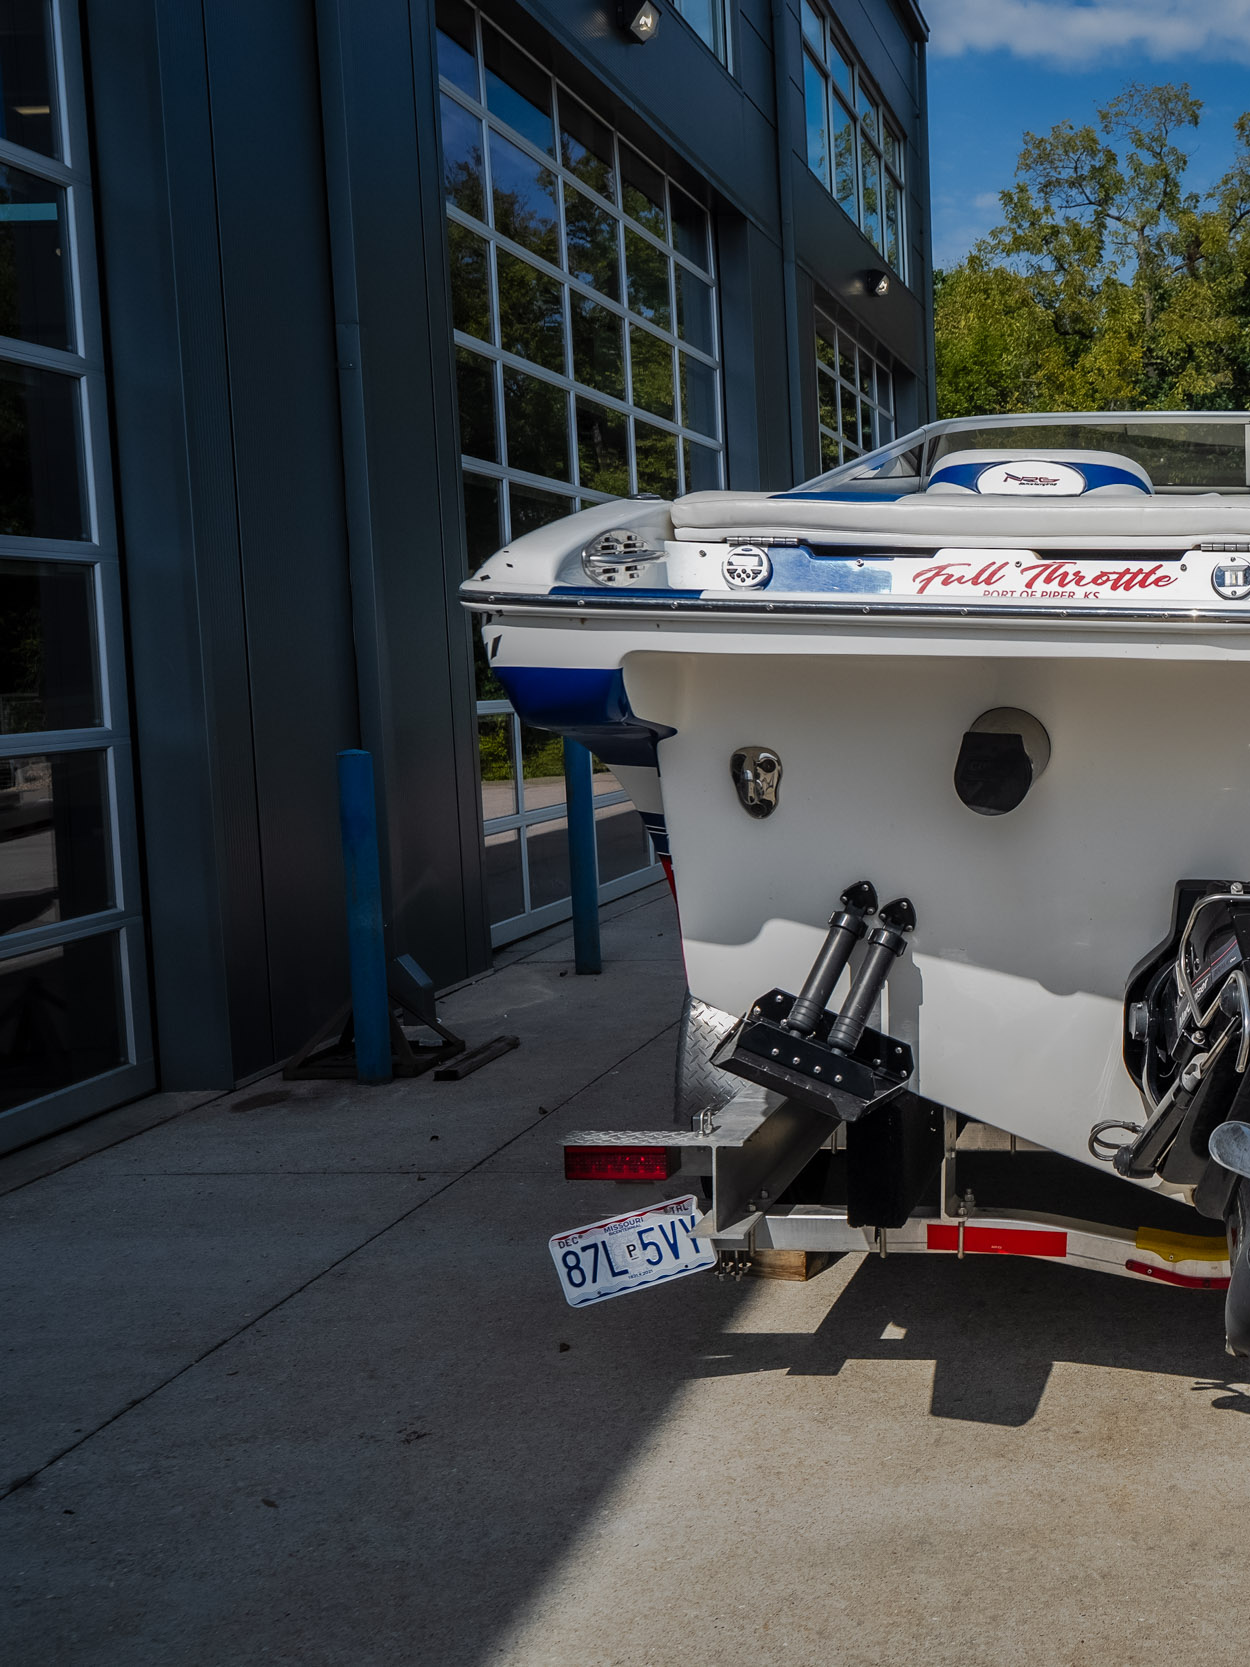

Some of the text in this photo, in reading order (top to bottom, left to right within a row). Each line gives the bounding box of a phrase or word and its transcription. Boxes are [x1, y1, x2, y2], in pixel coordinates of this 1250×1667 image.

[912, 561, 1178, 594] Full Throttle
[1020, 590, 1037, 598] OF
[1084, 591, 1100, 599] KS
[671, 1204, 689, 1215] TRL
[603, 1217, 644, 1233] MISSOURI
[558, 1236, 580, 1249] DEC
[562, 1214, 701, 1288] 87L P 5VY
